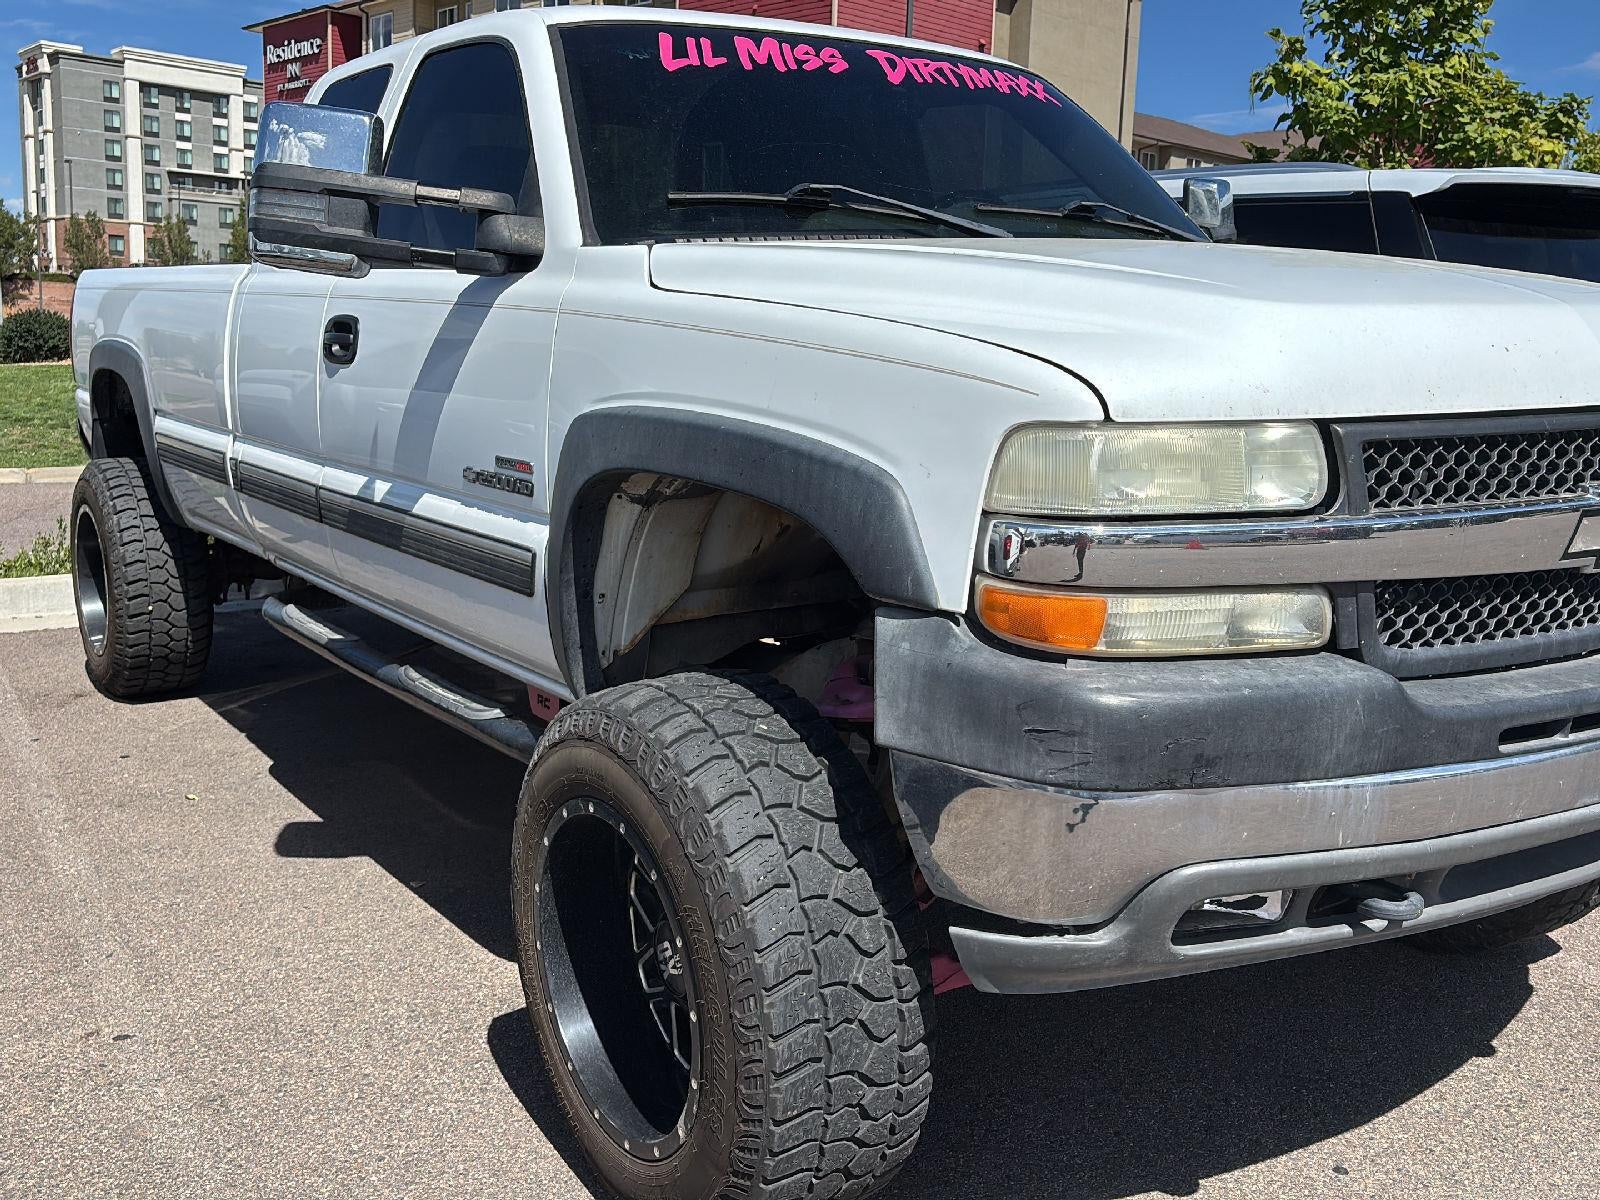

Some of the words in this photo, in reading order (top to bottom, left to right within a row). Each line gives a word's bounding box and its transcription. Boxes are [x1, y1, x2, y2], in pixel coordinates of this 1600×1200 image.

[266, 37, 323, 65] Residence
[658, 31, 727, 72] LIL
[734, 36, 850, 74] MISS
[865, 49, 1062, 107] DIRTYMAXX
